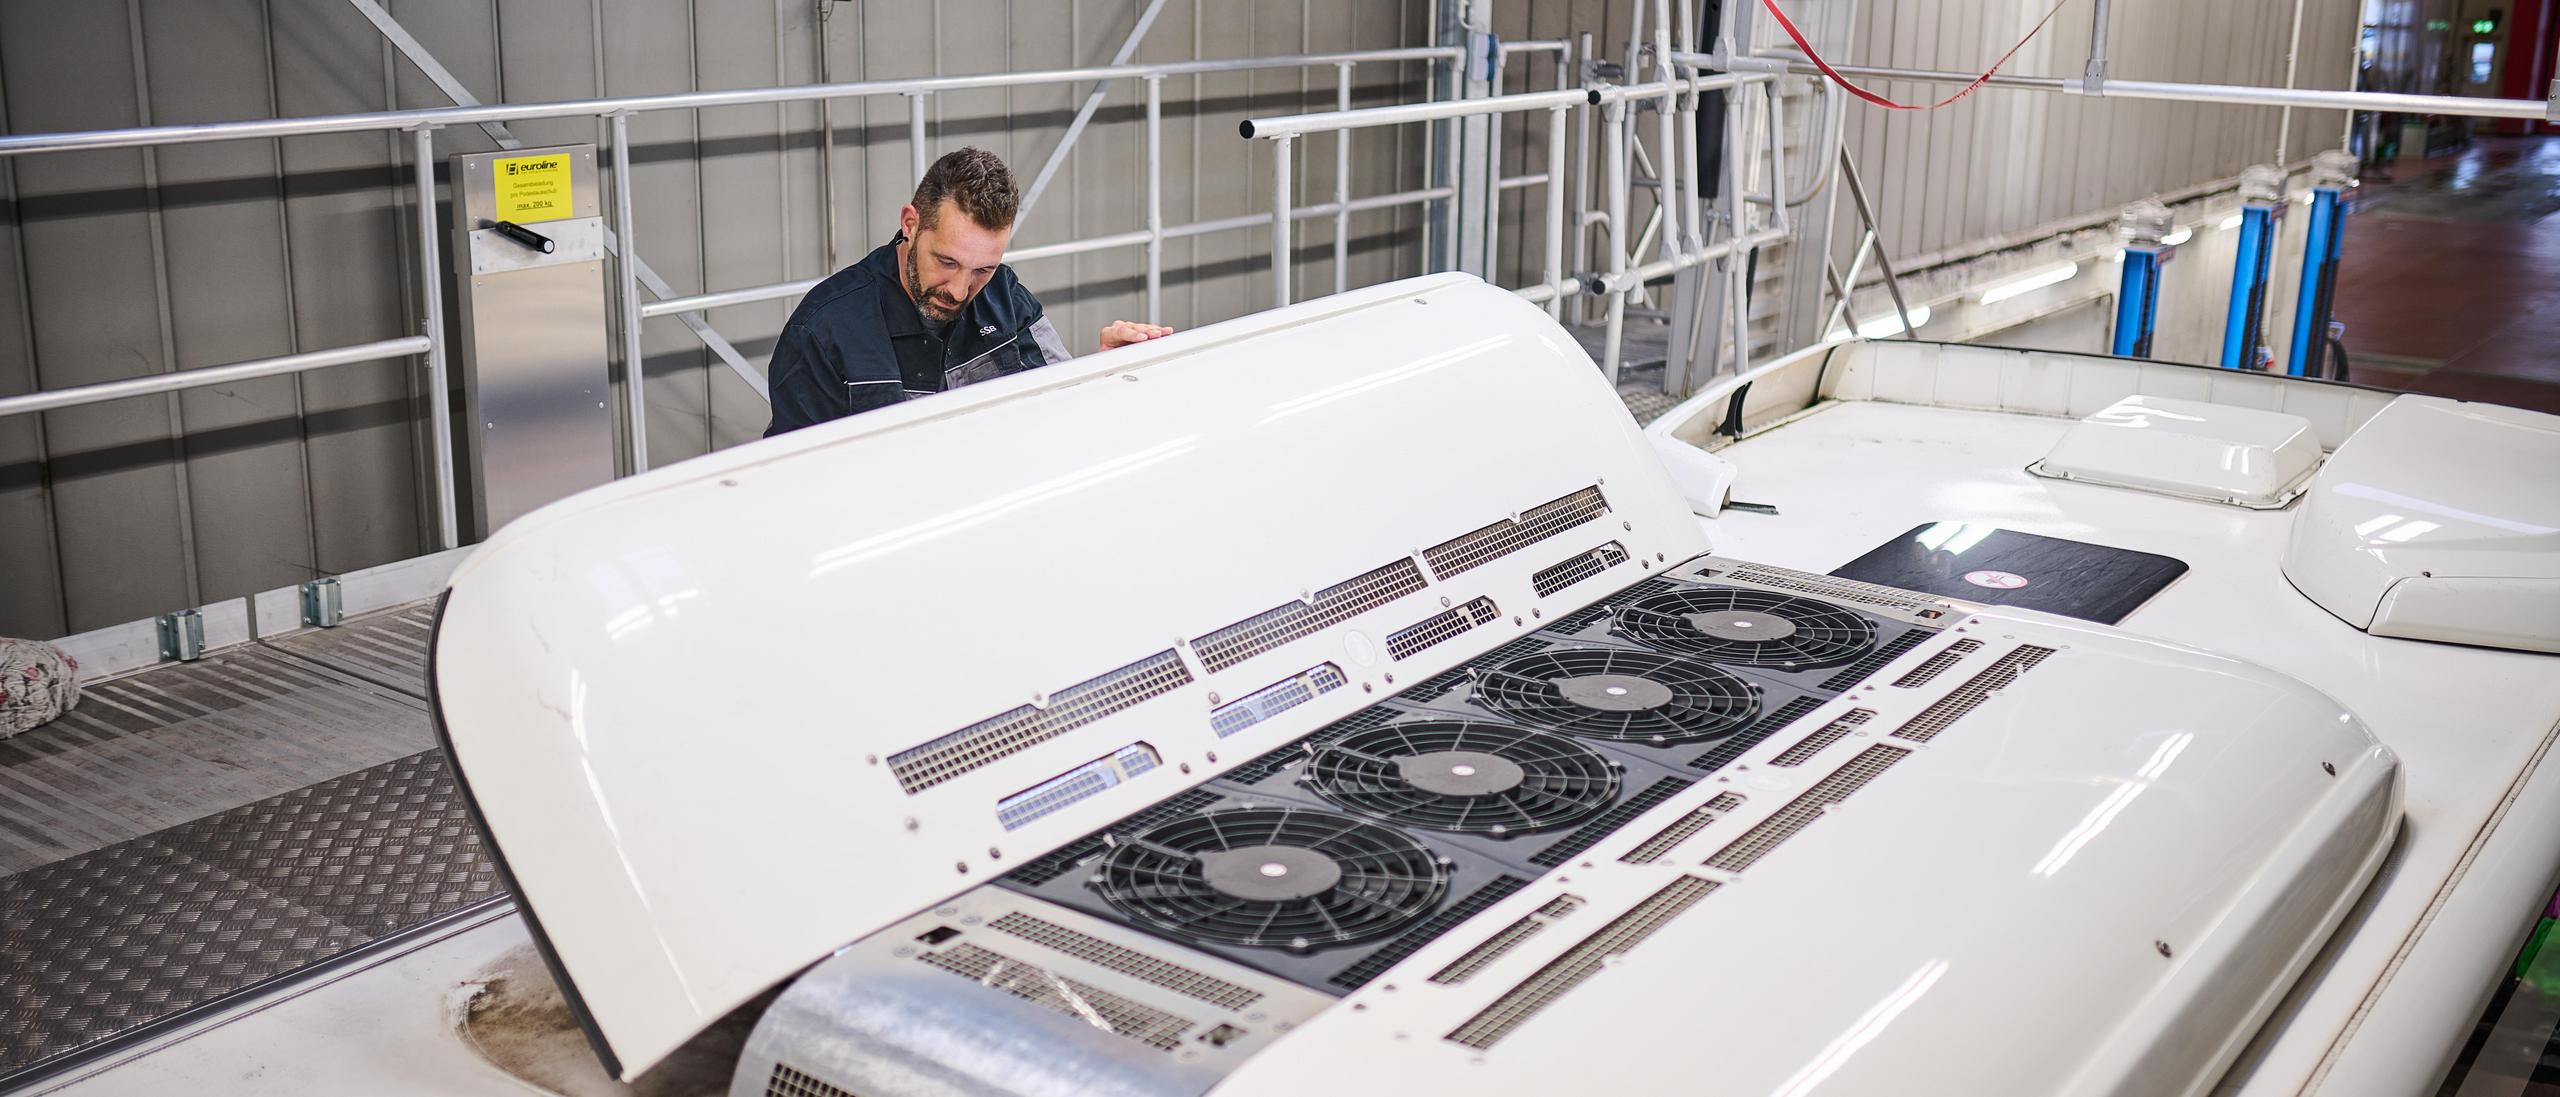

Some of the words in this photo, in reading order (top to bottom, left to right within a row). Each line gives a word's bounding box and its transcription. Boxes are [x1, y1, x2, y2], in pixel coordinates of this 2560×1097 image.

[520, 160, 557, 171] euroline
[544, 200, 553, 208] kg
[979, 325, 997, 337] SSB
